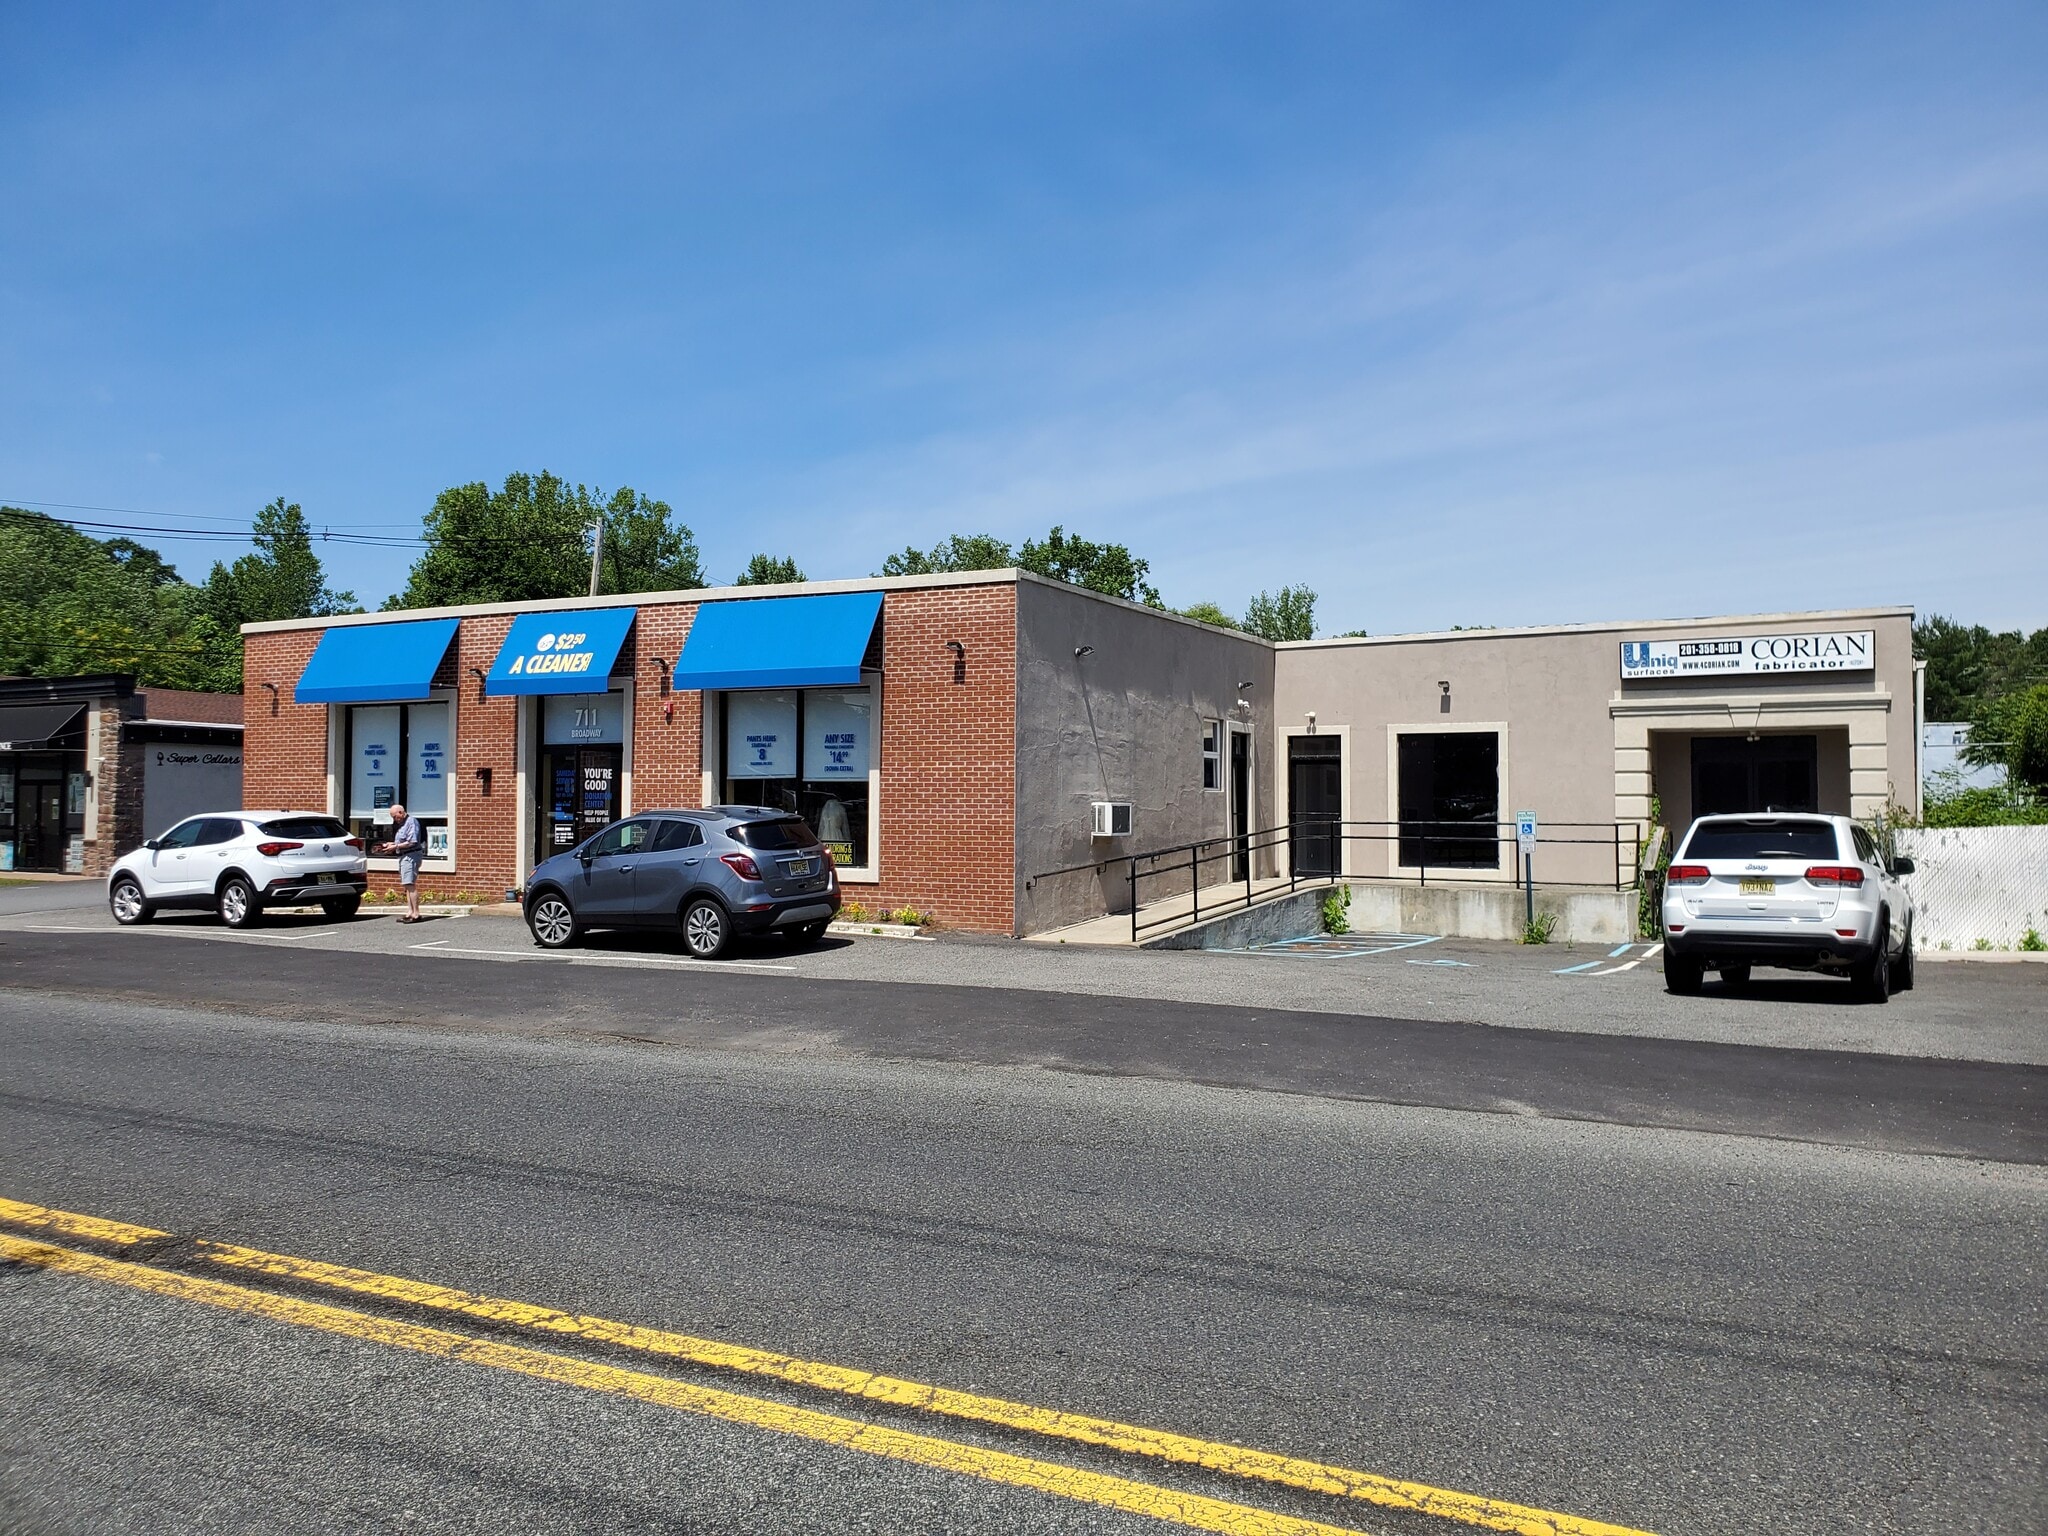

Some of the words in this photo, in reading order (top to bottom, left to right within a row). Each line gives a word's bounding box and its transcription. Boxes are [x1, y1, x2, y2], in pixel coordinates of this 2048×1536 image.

[1751, 635, 1867, 660] CORIAN
[1623, 642, 1678, 669] Uniq
[508, 656, 525, 674] A
[1755, 659, 1845, 671] fabricator
[575, 708, 597, 726] 711
[571, 728, 602, 738] BROADWAY
[825, 734, 839, 743] ANY
[841, 733, 855, 743] SIZE
[167, 753, 200, 765] Super
[203, 754, 240, 764] Cellars
[584, 768, 613, 779] YOU'RE
[584, 780, 607, 791] GOOD
[848, 844, 853, 853] &
